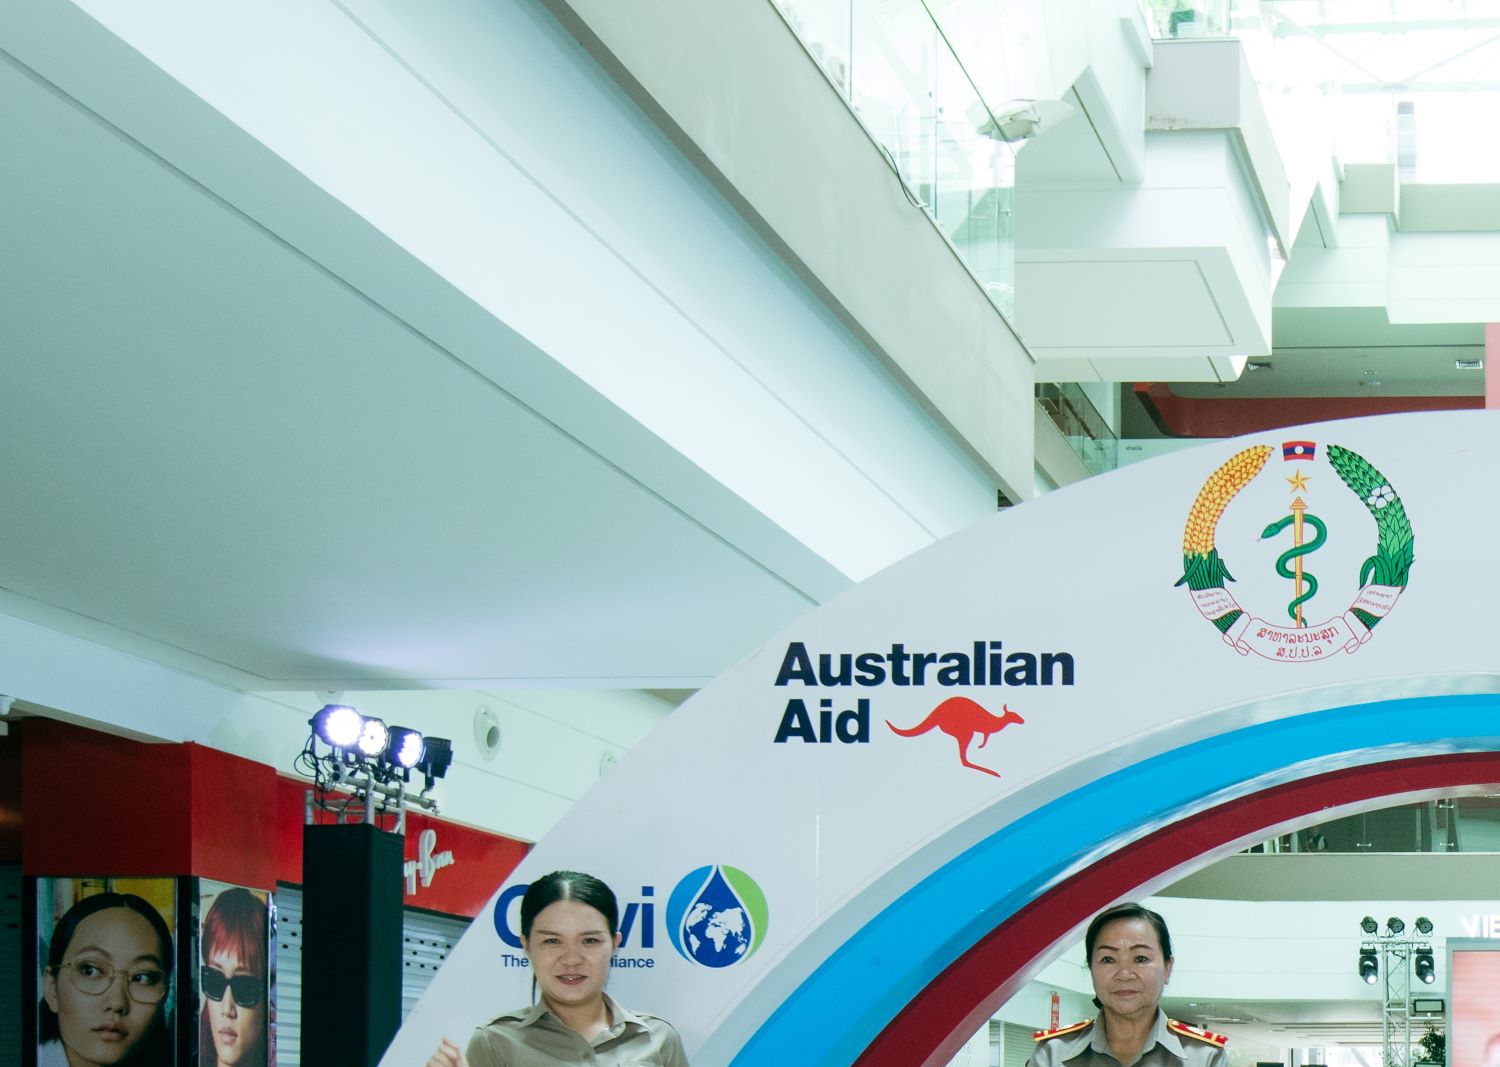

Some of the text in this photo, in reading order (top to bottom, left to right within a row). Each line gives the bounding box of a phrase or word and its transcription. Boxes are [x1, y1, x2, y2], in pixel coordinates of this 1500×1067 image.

[775, 641, 1075, 687] Australian
[774, 698, 870, 744] Aid
[501, 954, 529, 968] The
